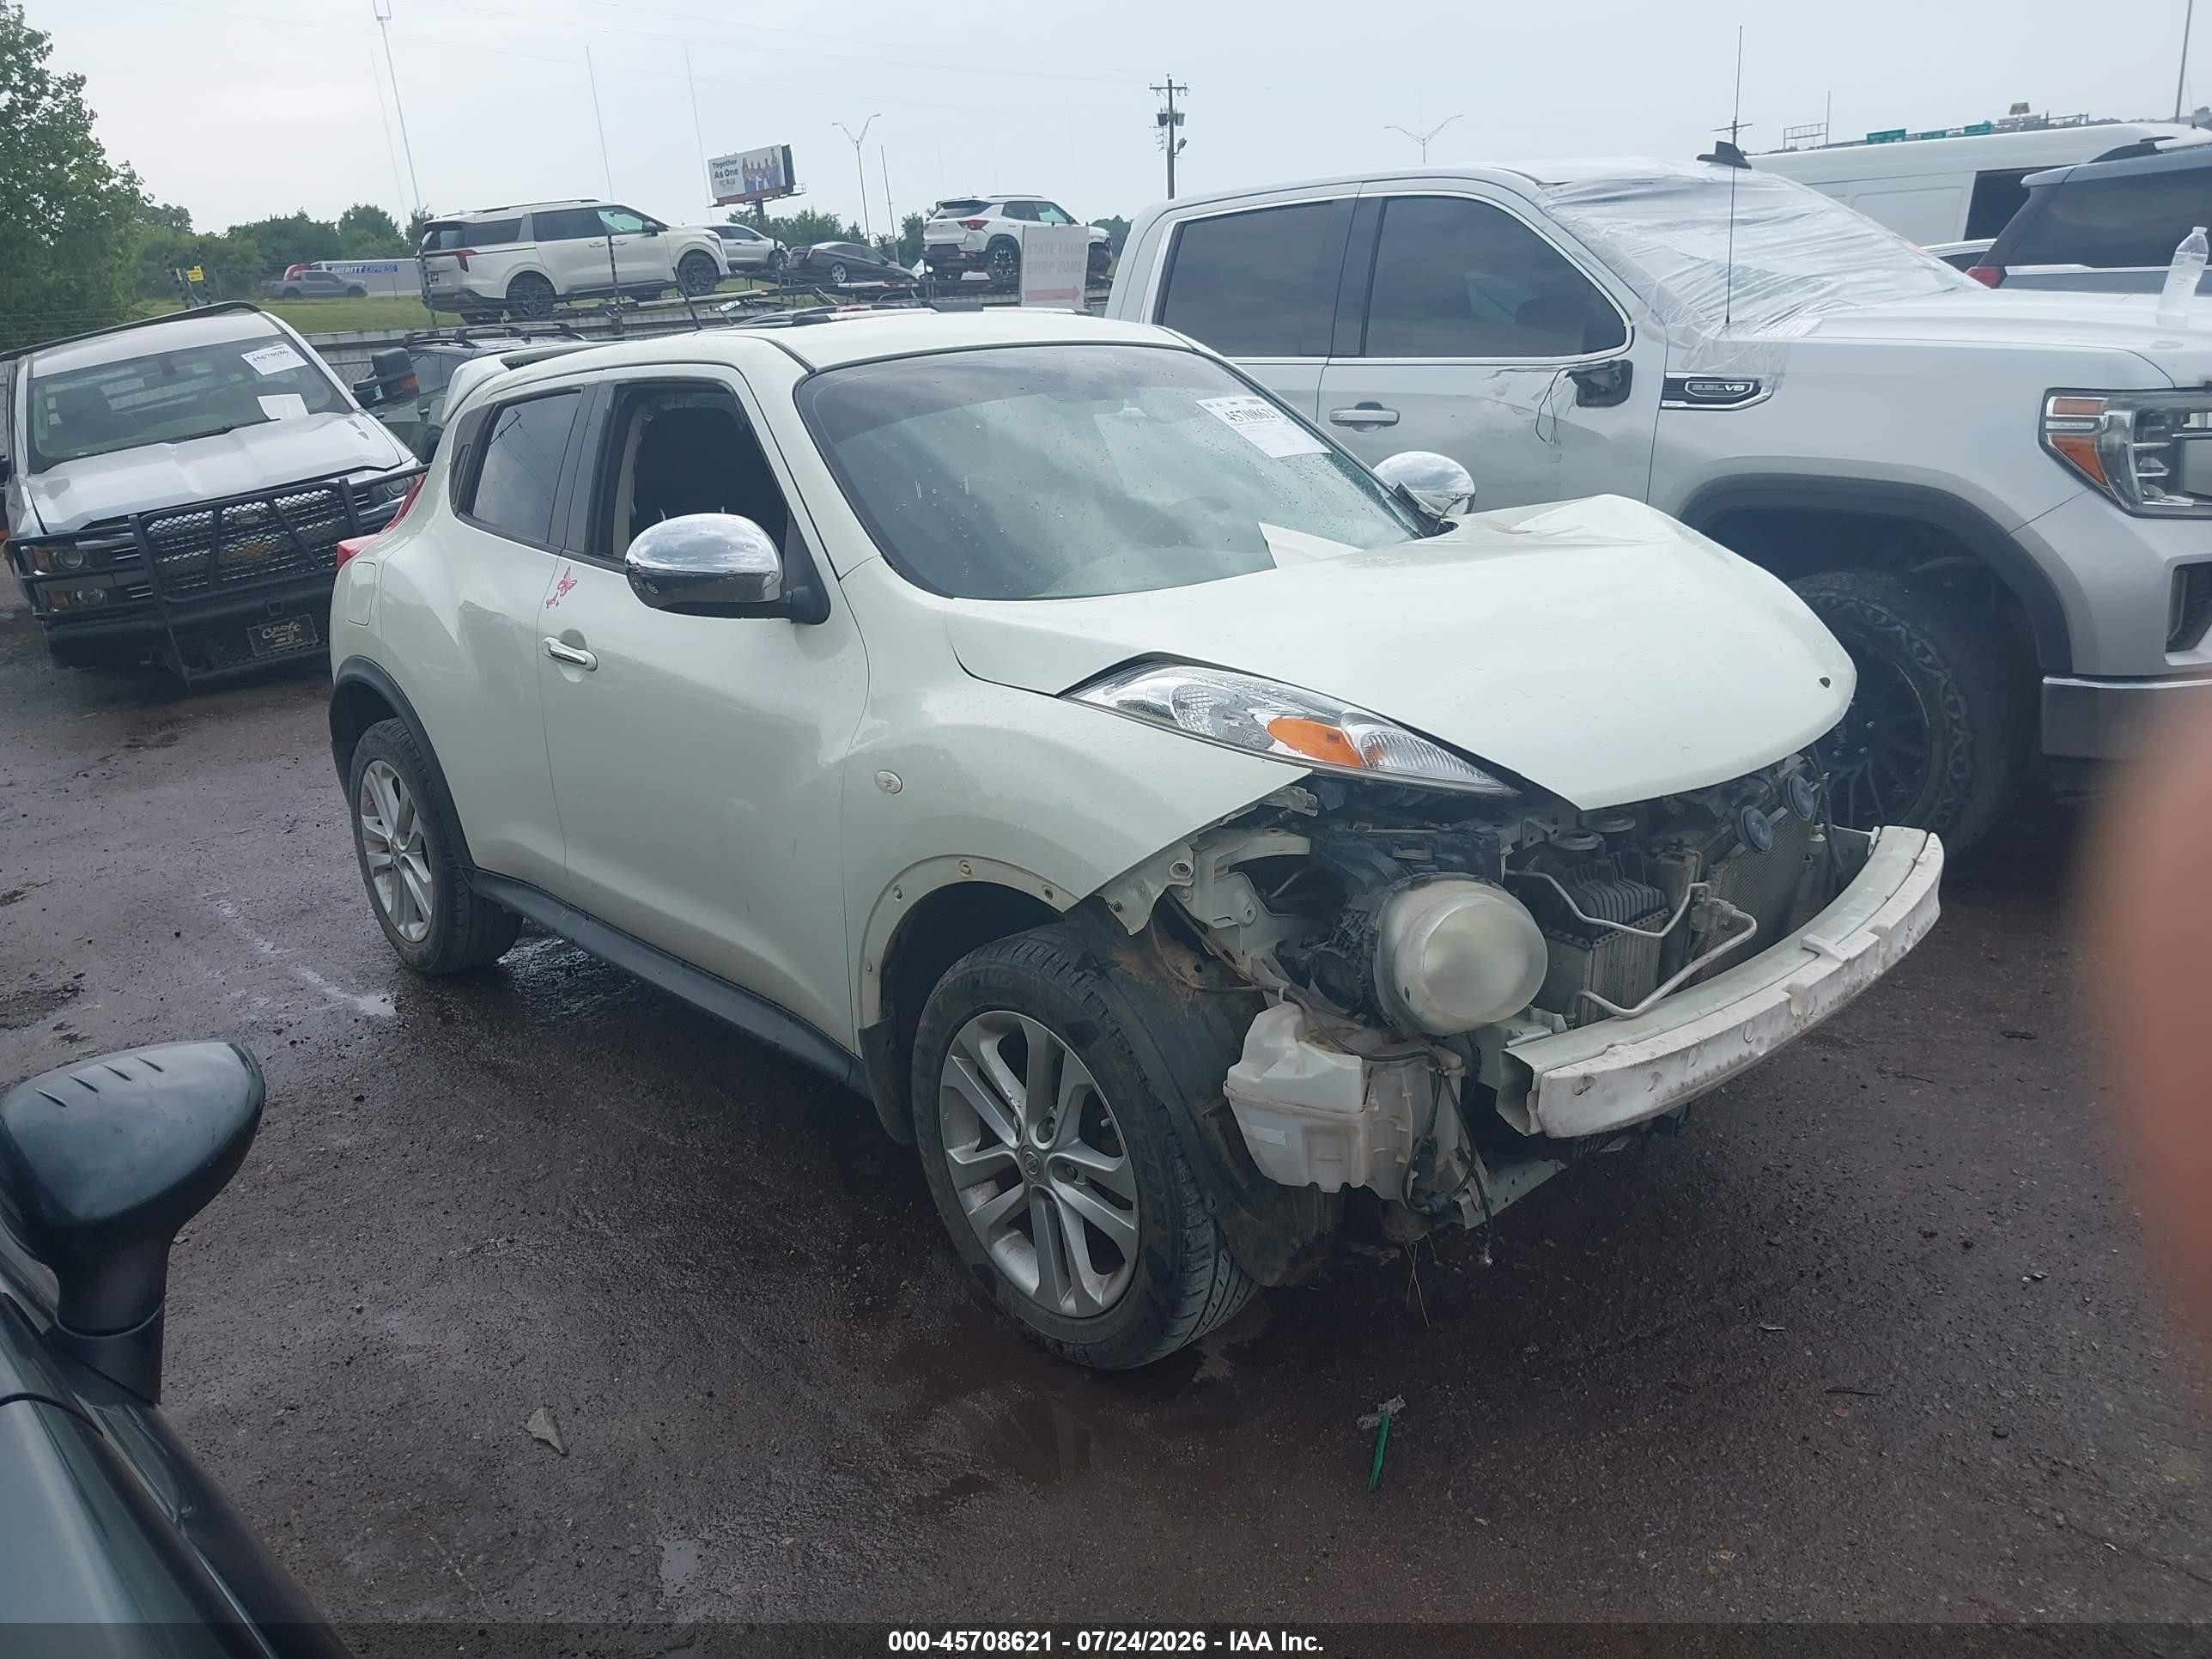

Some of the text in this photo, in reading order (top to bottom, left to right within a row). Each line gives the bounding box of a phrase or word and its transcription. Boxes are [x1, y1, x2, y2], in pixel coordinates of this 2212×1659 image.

[712, 159, 737, 170] Together
[724, 168, 738, 177] One
[1027, 242, 1087, 256] STATE FARM
[1028, 260, 1084, 274] DROP ZONE
[1224, 408, 1280, 422] 45708621
